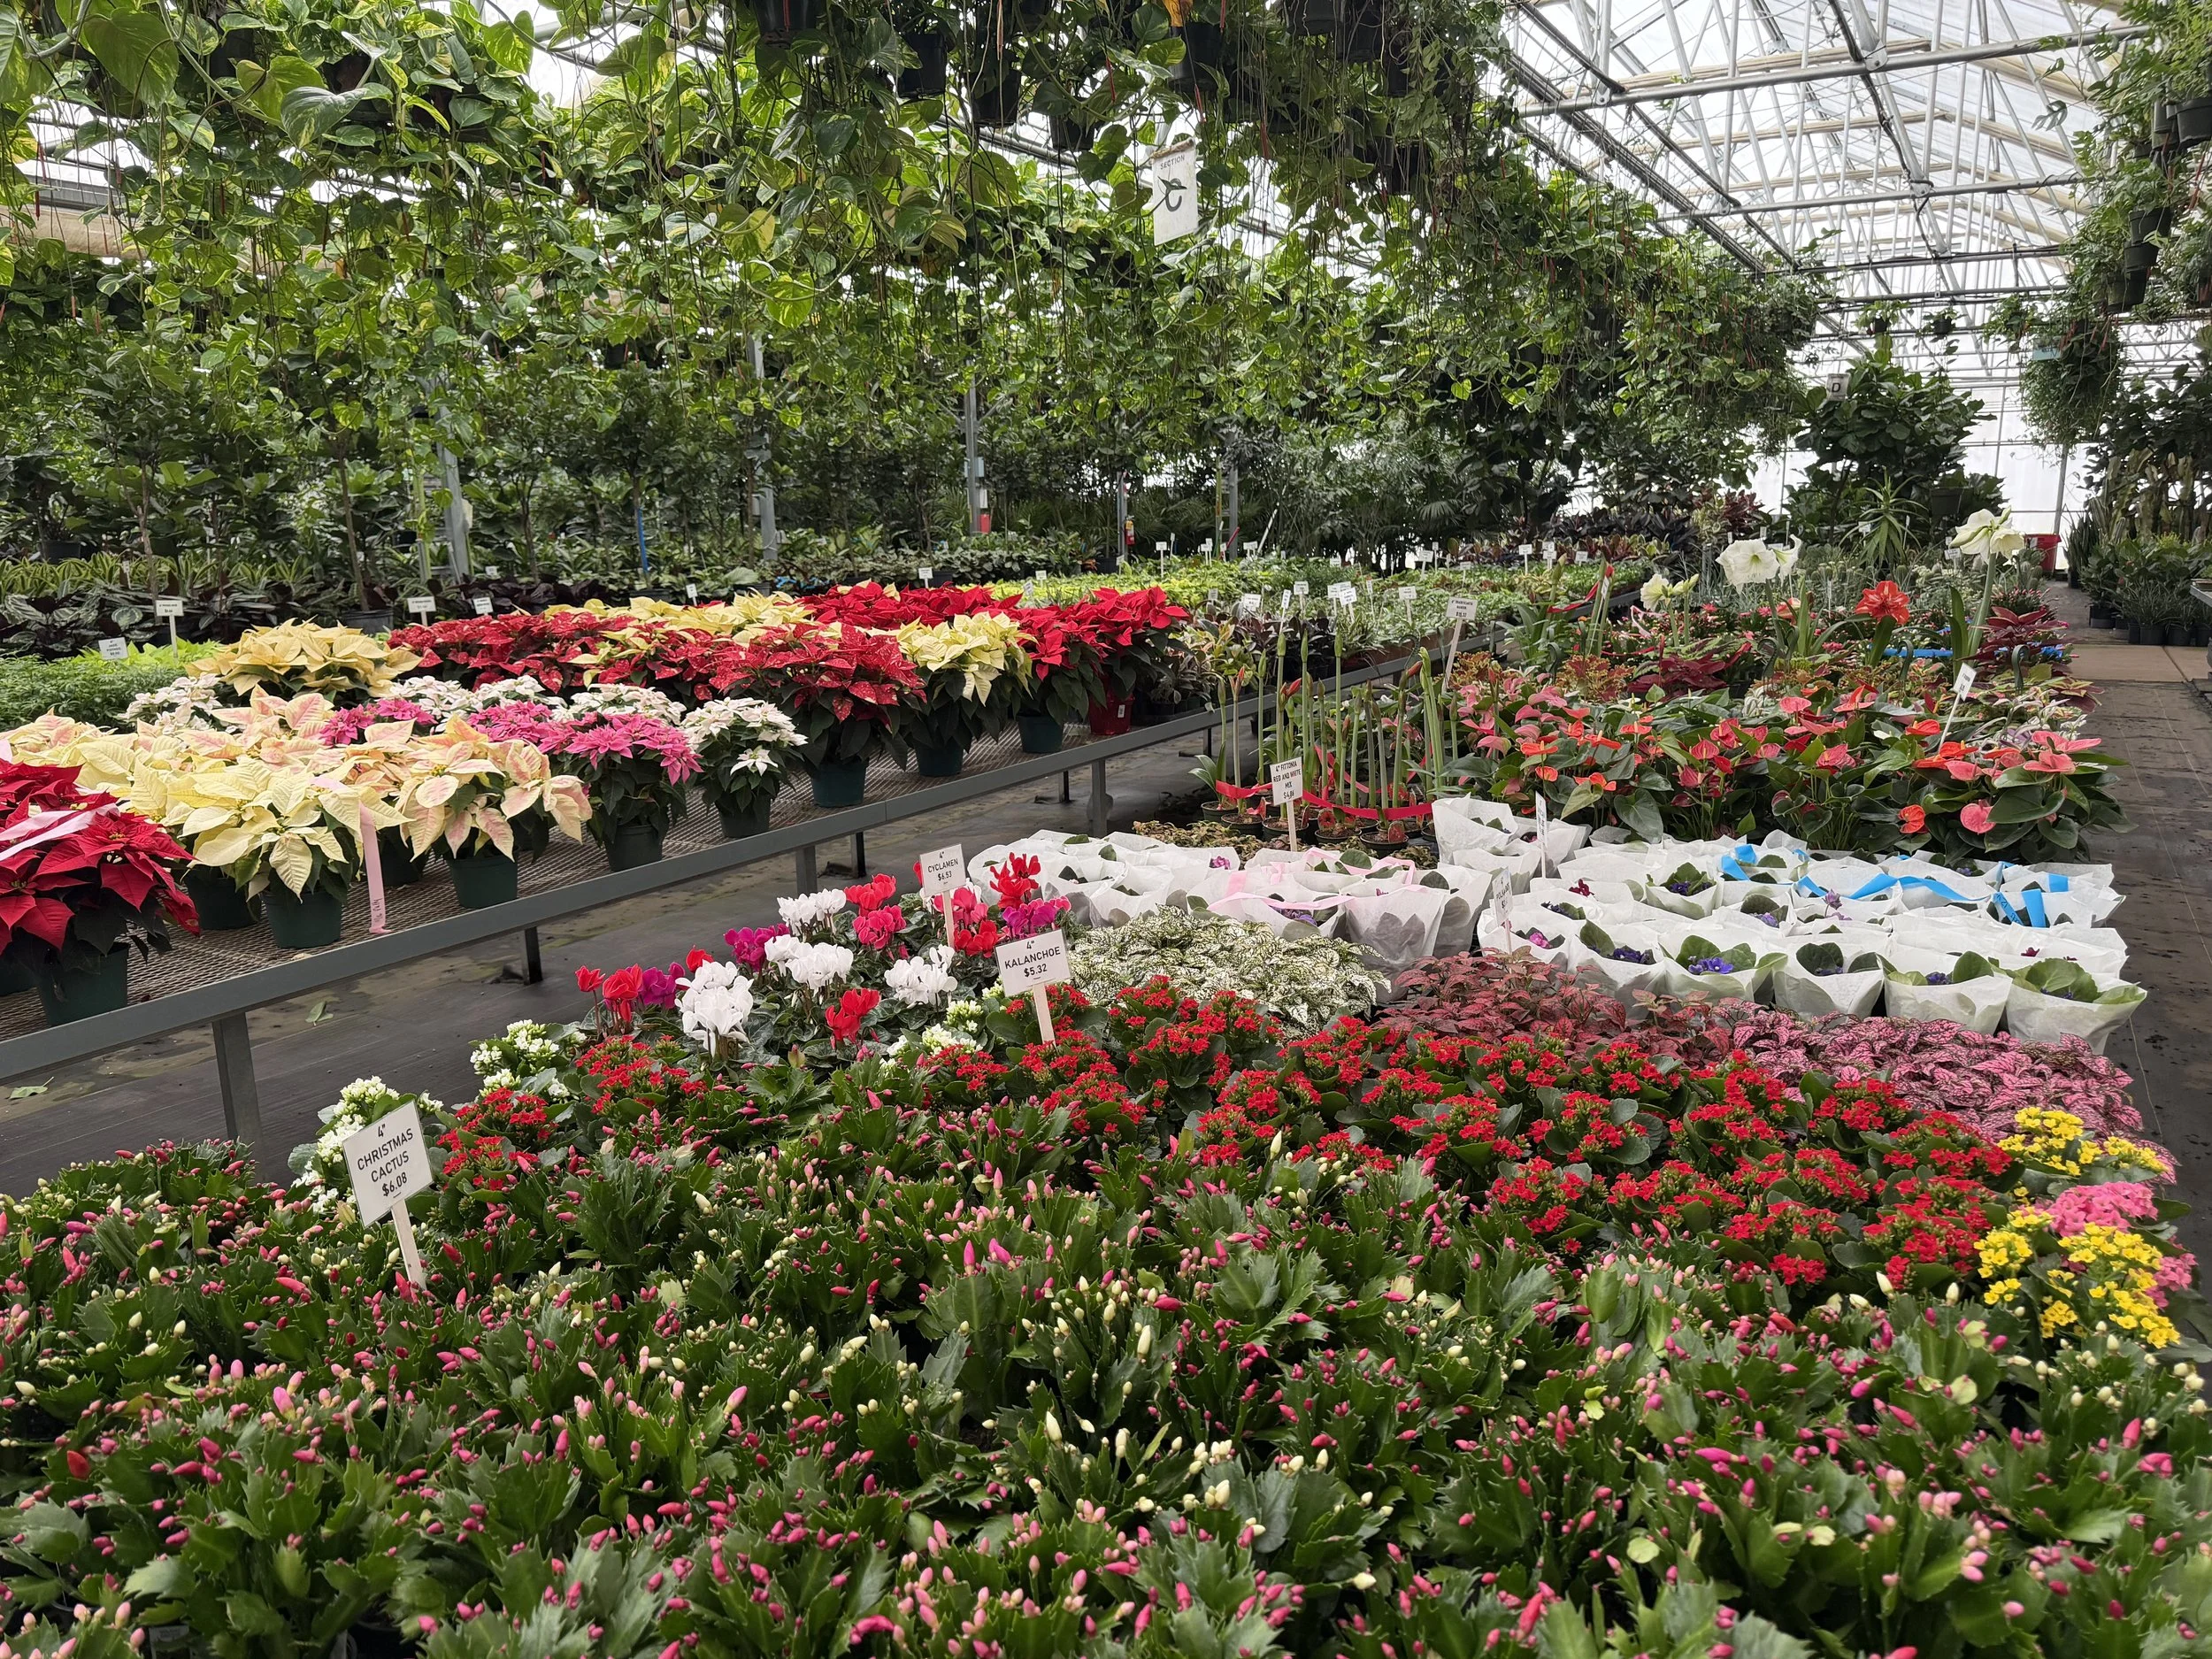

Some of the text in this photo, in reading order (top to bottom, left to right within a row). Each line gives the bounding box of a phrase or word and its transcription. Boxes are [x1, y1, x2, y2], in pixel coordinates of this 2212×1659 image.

[1160, 154, 1186, 170] SECTION
[1831, 382, 1841, 393] D
[1280, 760, 1298, 772] FITTONIA
[1290, 769, 1302, 778] WHITE
[927, 858, 958, 873] CYCLAMEN
[937, 871, 952, 881] $6.53
[1025, 940, 1035, 949] 4"
[1004, 946, 1061, 970] KALANCHOE
[1024, 963, 1048, 978] $5.32
[377, 1123, 386, 1138] 4"
[357, 1127, 414, 1171] CHRISTMAS
[371, 1150, 410, 1183] CACTUS
[381, 1171, 408, 1197] $6.08
